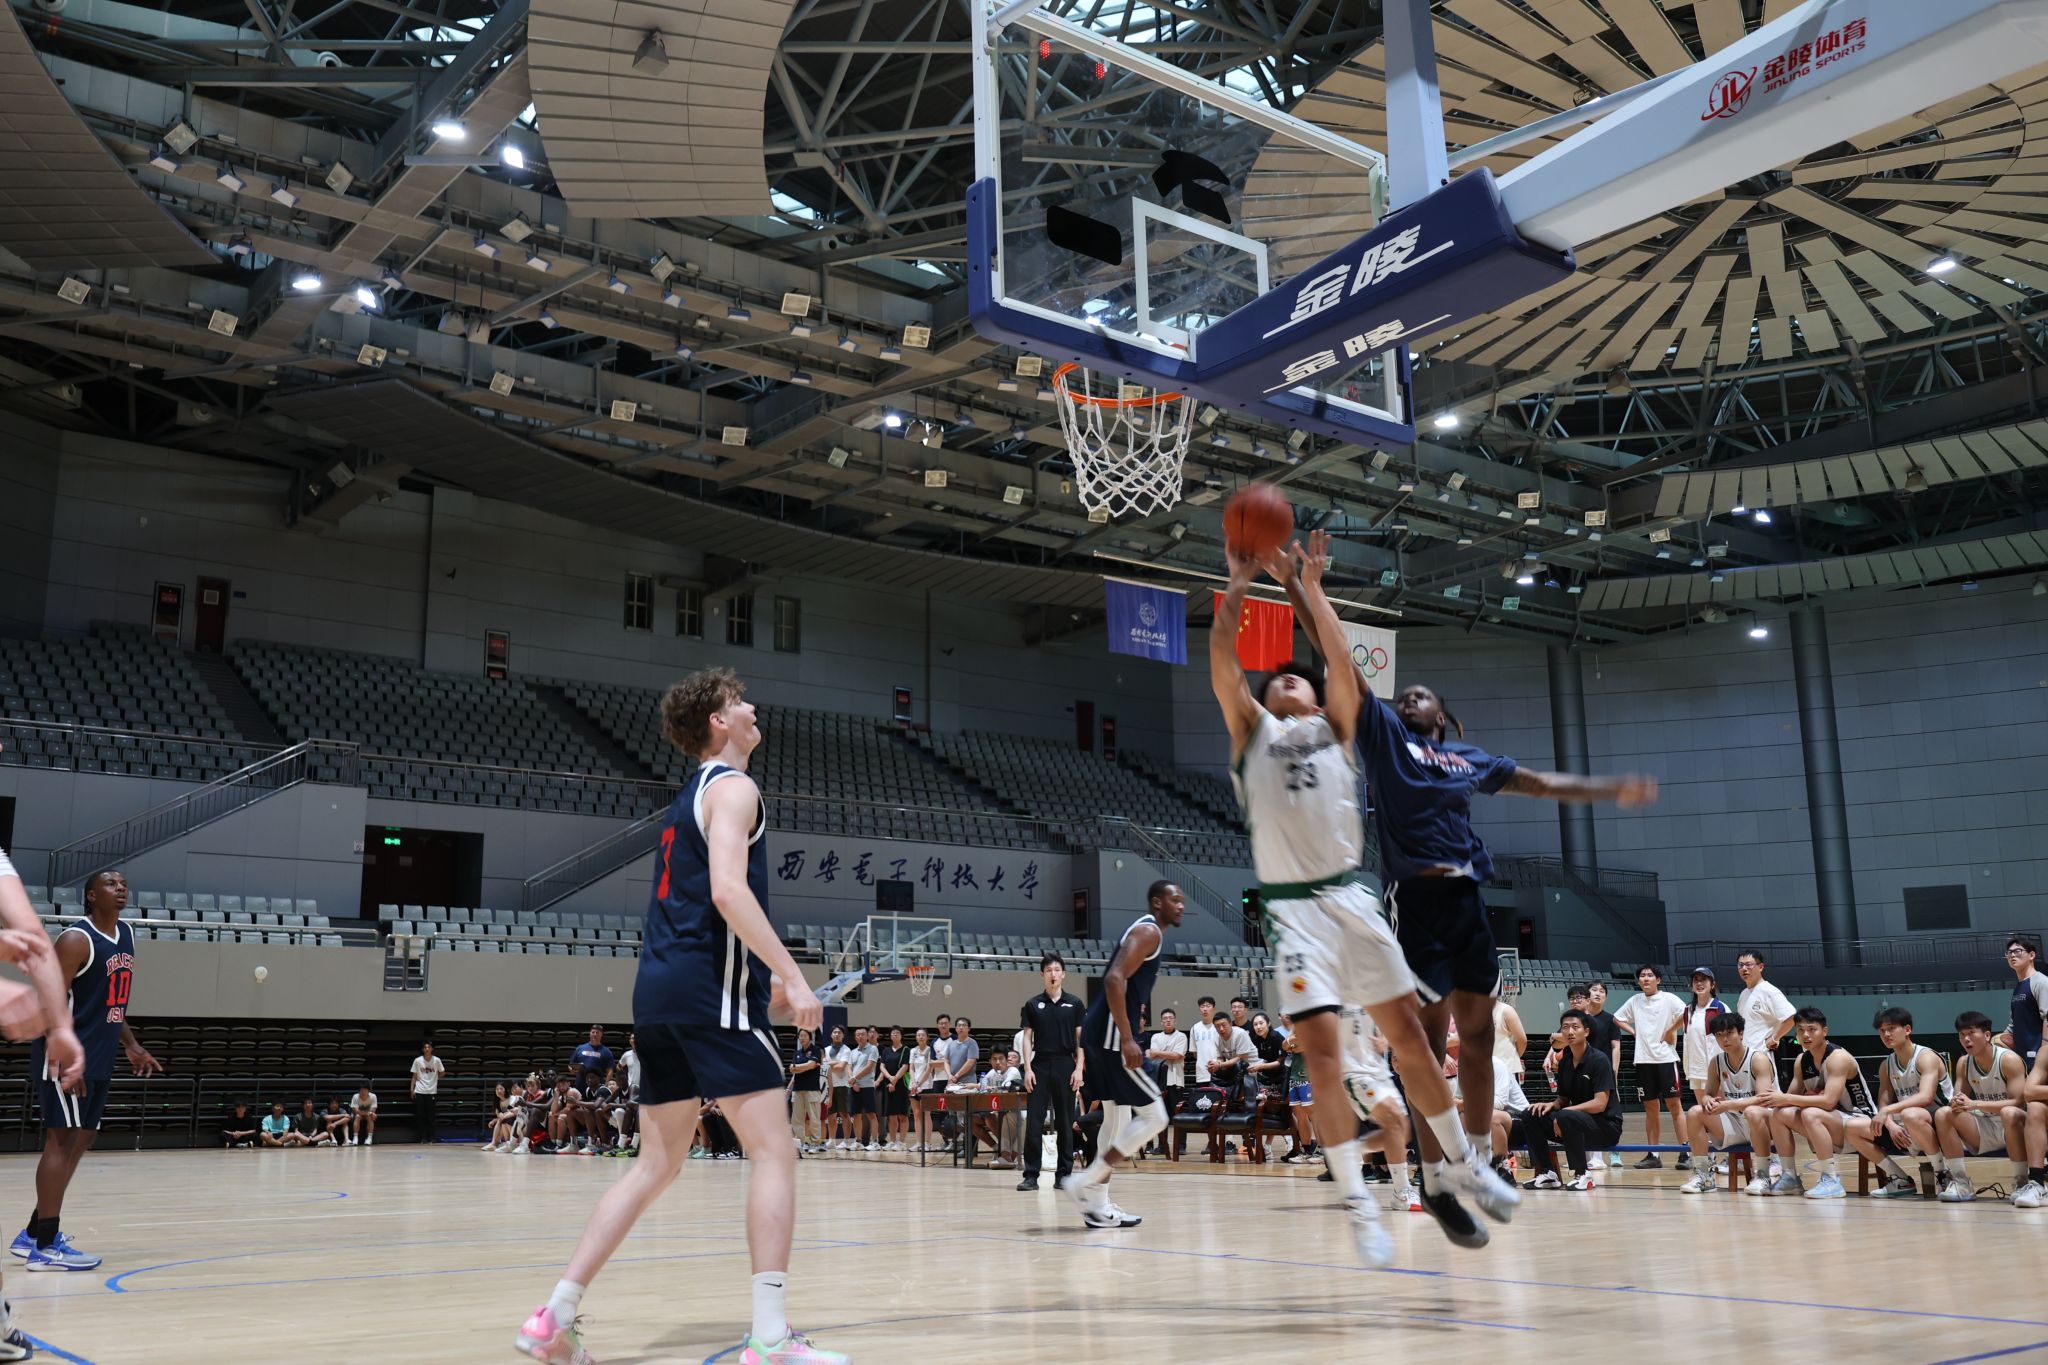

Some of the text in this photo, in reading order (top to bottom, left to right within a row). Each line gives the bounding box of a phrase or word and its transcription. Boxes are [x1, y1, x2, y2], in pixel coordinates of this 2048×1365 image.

[1815, 41, 1866, 69] SPORTS
[657, 826, 676, 900] 7
[106, 971, 131, 1006] 10
[991, 1096, 998, 1110] 6
